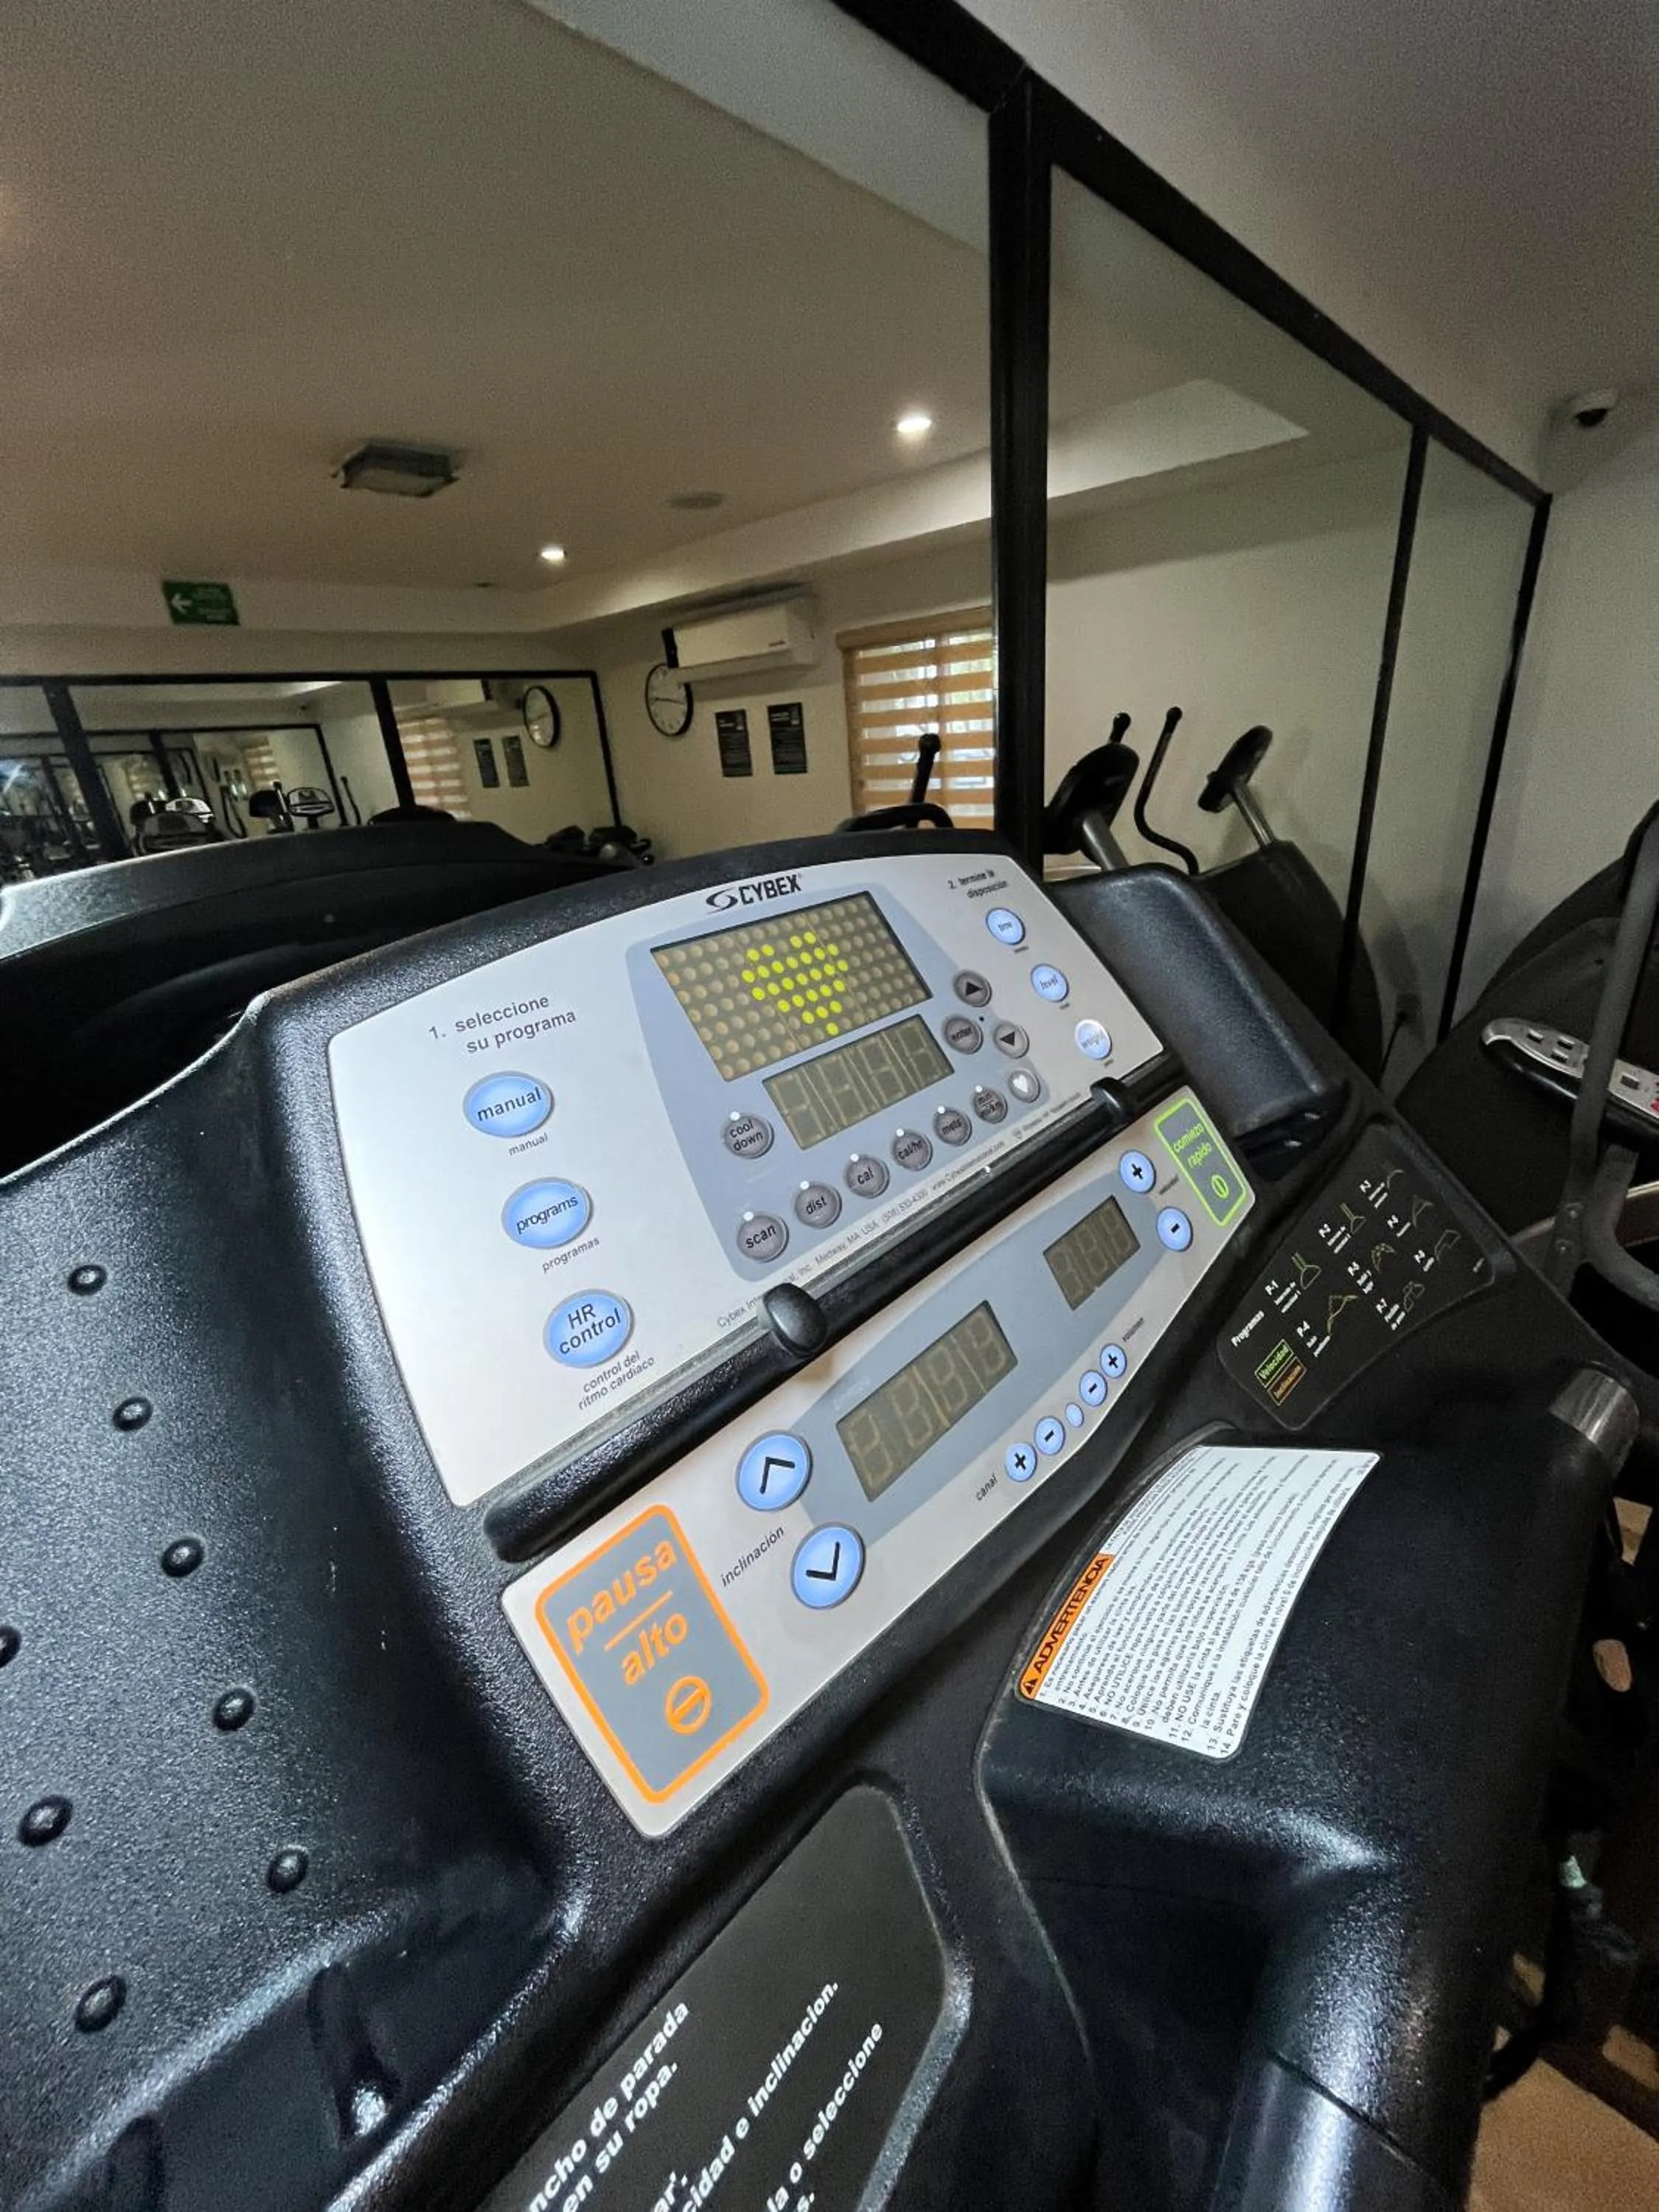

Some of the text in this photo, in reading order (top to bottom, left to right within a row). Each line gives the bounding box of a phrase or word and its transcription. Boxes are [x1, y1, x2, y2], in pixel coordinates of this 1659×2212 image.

[739, 875, 801, 906] CYBEX
[1039, 975, 1058, 990] level
[428, 995, 549, 1040] 1. seleccione
[466, 1009, 577, 1054] su programa
[476, 1088, 543, 1121] manual
[729, 1119, 754, 1140] cool
[733, 1129, 764, 1152] down
[508, 1133, 549, 1156] manual
[857, 1167, 874, 1185] cal
[516, 1194, 579, 1234] programs
[805, 1195, 827, 1215] dist
[745, 1224, 776, 1249] scan
[541, 1237, 600, 1273] programas
[567, 1302, 597, 1329] HR
[717, 1306, 746, 1329] Cybex
[1231, 1310, 1265, 1348] Programas
[558, 1309, 622, 1356] control
[582, 1349, 640, 1392] control del
[577, 1382, 609, 1411] ritmo
[975, 1473, 998, 1501] canal
[720, 1524, 785, 1588] inclinación
[566, 1539, 678, 1655] pausa
[1032, 1554, 1109, 1674] ADVERTENCIA
[621, 1613, 688, 1686] alto
[1259, 1627, 1274, 1652] cinta
[1195, 1645, 1212, 1671] cinta
[1254, 1649, 1265, 1663] la
[1073, 1668, 1091, 1696] Antes
[1103, 1689, 1116, 1707] NO
[1110, 1651, 1133, 1690] UTILICE
[1191, 1669, 1201, 1682] la
[1239, 1660, 1261, 1703] coloque
[1114, 1694, 1127, 1710] No
[1125, 1672, 1149, 1713] Coloque
[1136, 1684, 1156, 1717] Utilice
[1150, 1697, 1163, 1714] No
[1180, 1680, 1196, 1705] USE
[1187, 1669, 1216, 1725] Comunique
[1161, 1691, 1180, 1725] deben
[1174, 1703, 1188, 1722] NO
[1211, 1683, 1238, 1733] Sustituya
[1167, 1721, 1180, 1739] 11.
[1200, 1717, 1211, 1731] la
[1225, 1711, 1242, 1738] Pare
[1206, 1733, 1220, 1752] 13.
[1220, 1739, 1231, 1757] 14.
[591, 2096, 618, 2137] de
[621, 2002, 689, 2101] parada
[735, 2117, 750, 2139] e
[747, 1982, 838, 2117] inclinacion.
[790, 2161, 803, 2184] o
[803, 2023, 883, 2161] seleccione
[563, 2062, 678, 2212] en su ropa.
